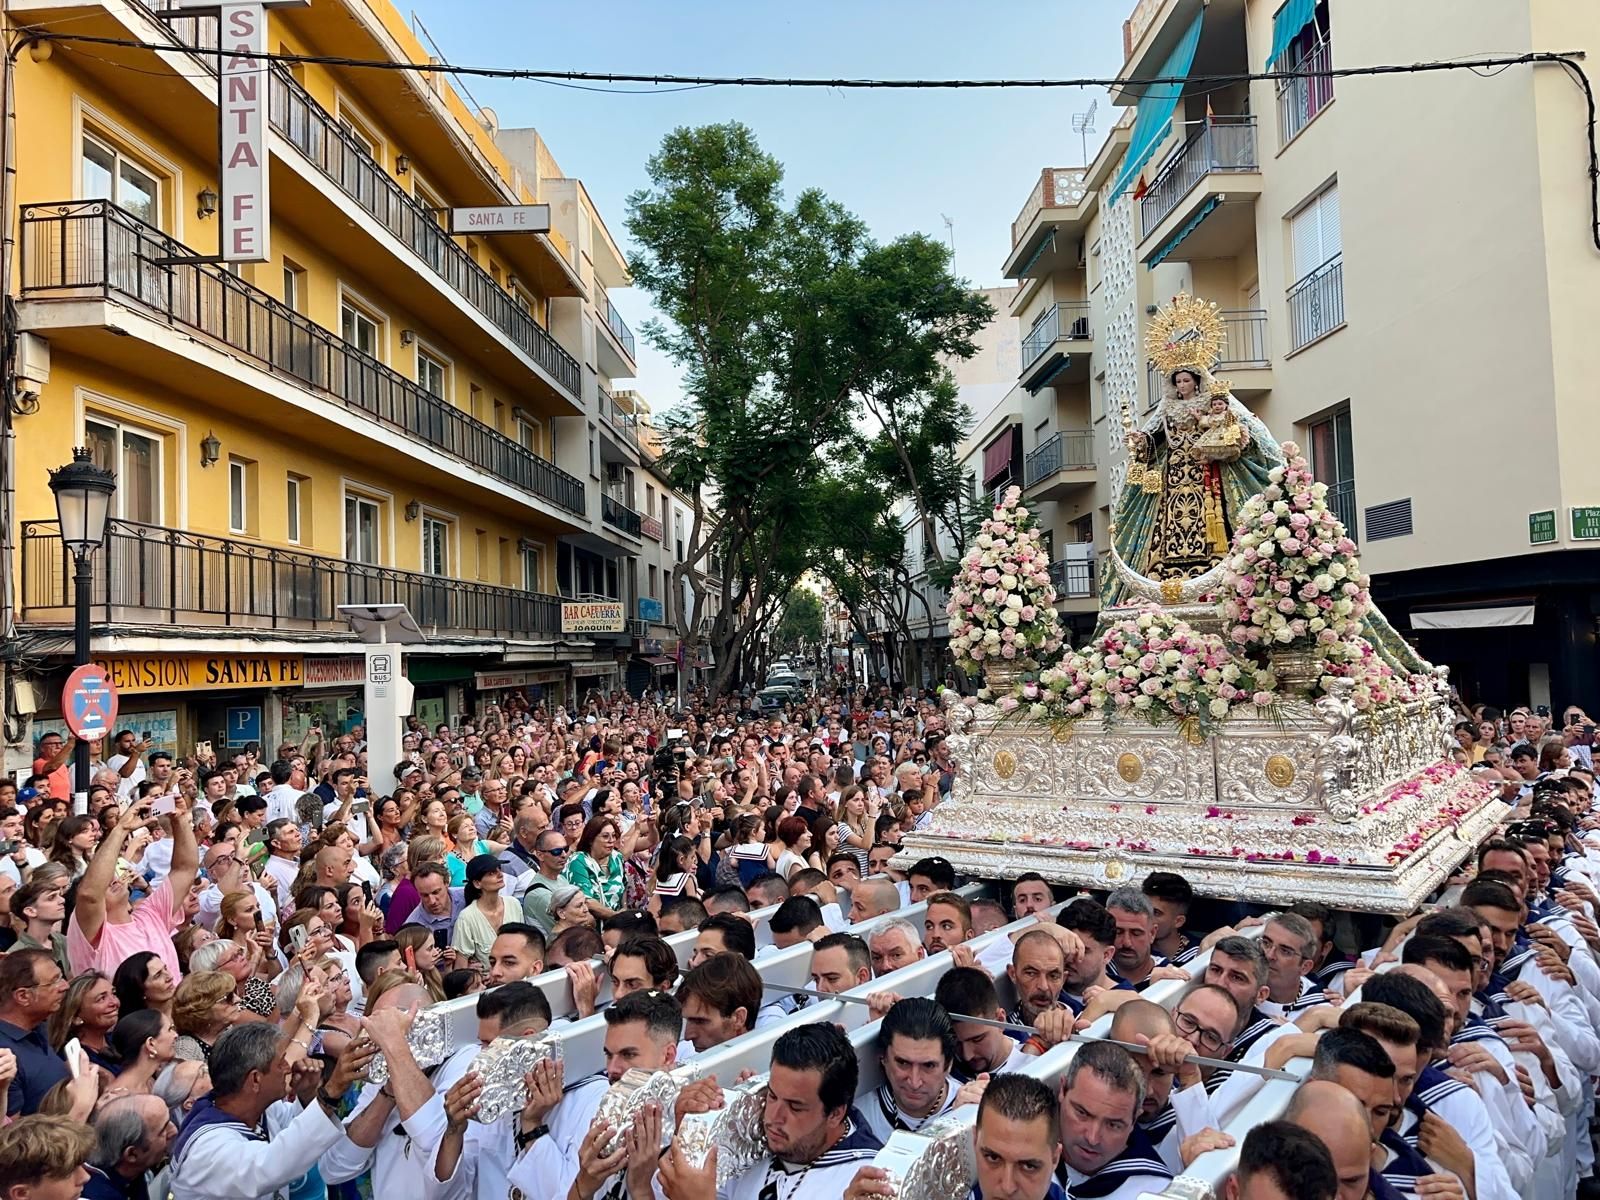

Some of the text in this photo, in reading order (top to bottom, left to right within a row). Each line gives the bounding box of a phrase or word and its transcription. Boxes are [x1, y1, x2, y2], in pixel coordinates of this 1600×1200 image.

[227, 10, 258, 254] SANTA FE
[468, 211, 526, 226] SANTA FE
[564, 605, 579, 620] BAR
[206, 659, 272, 684] SANTA
[279, 658, 300, 682] FE
[236, 711, 251, 730] P
